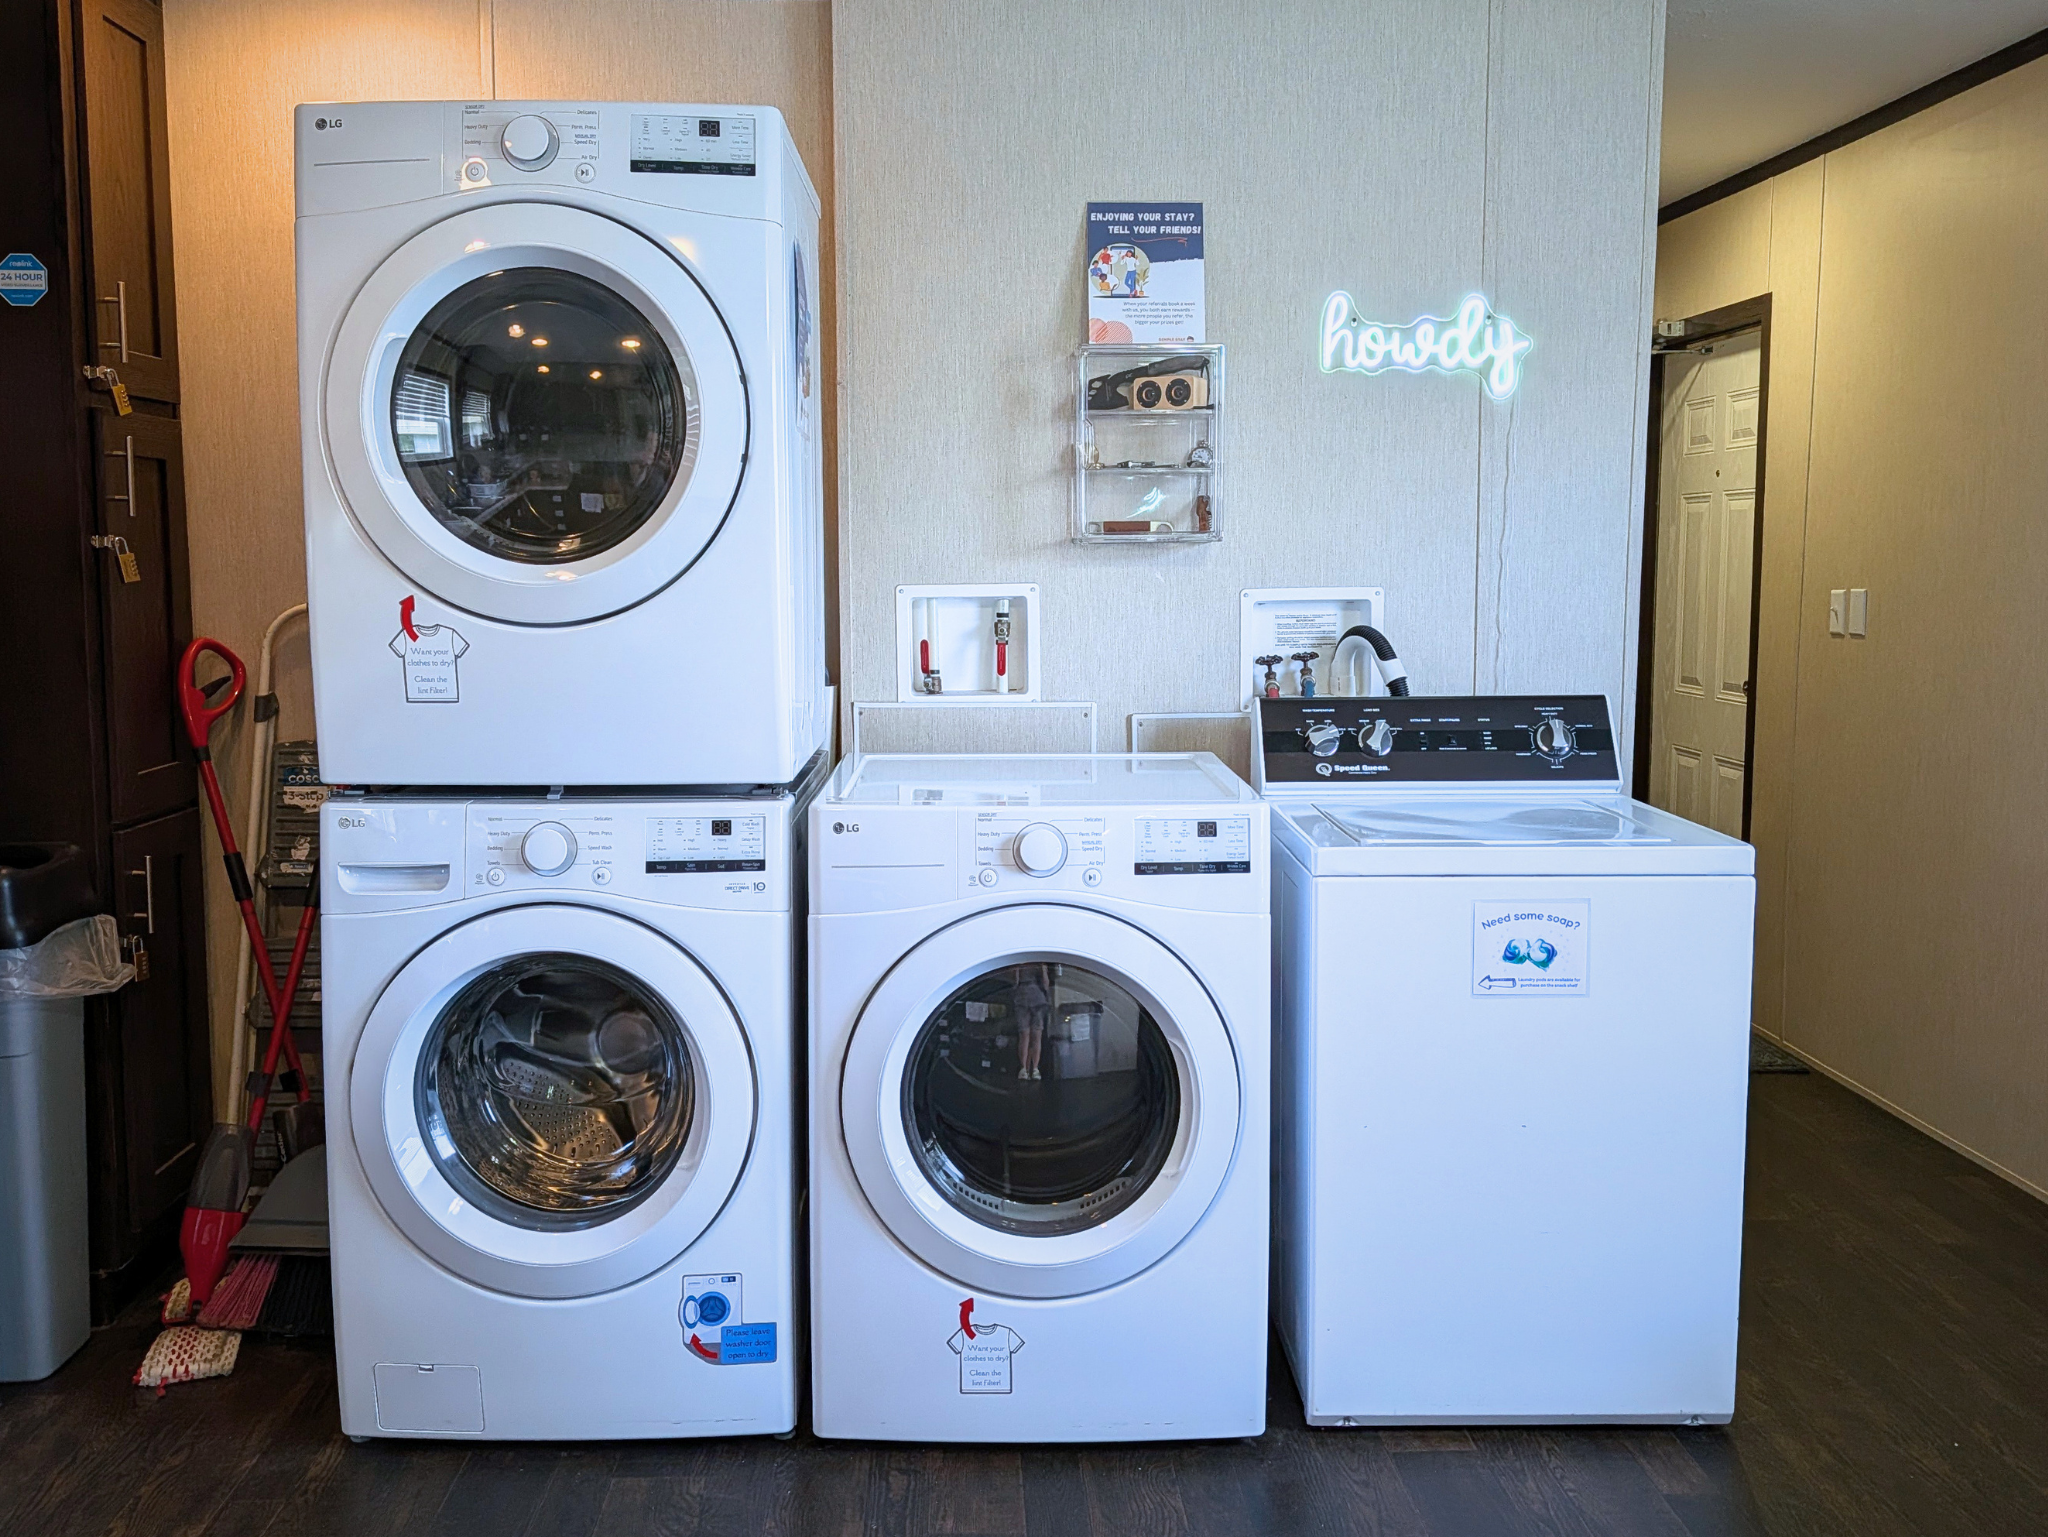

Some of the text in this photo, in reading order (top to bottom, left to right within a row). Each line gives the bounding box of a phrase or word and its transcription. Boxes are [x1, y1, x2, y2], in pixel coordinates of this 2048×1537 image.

[329, 119, 343, 129] LG
[1090, 212, 1195, 222] ENJOYING YOUR STAY?
[1108, 226, 1202, 234] TELL YOUR FRIENDS!
[0, 273, 43, 281] 24 HOUR
[1322, 294, 1530, 396] howdy
[440, 660, 454, 668] dry?
[352, 818, 366, 828] LG
[846, 824, 860, 833] LG
[753, 882, 766, 891] 10
[1481, 912, 1580, 930] Need some soap?
[726, 1339, 753, 1347] washer
[728, 1352, 746, 1360] open
[756, 1350, 768, 1358] dry
